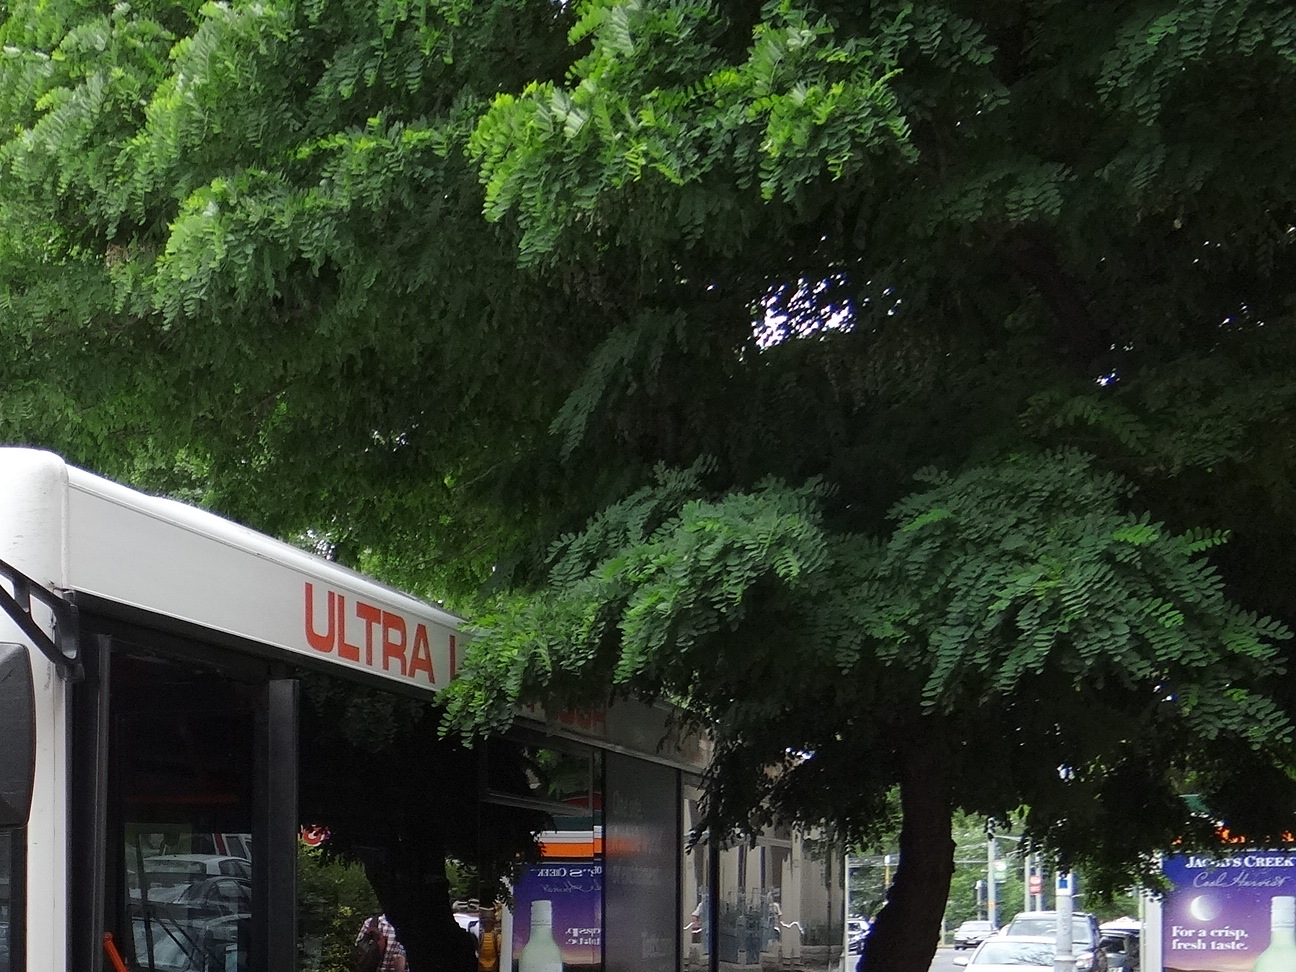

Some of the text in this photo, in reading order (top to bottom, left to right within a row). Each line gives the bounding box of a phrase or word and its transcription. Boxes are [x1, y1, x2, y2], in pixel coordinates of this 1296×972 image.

[304, 581, 436, 685] ULTRA
[1243, 855, 1295, 868] CREEK
[1172, 925, 1249, 941] For a crisp,
[1171, 938, 1249, 950] fresh taste.
